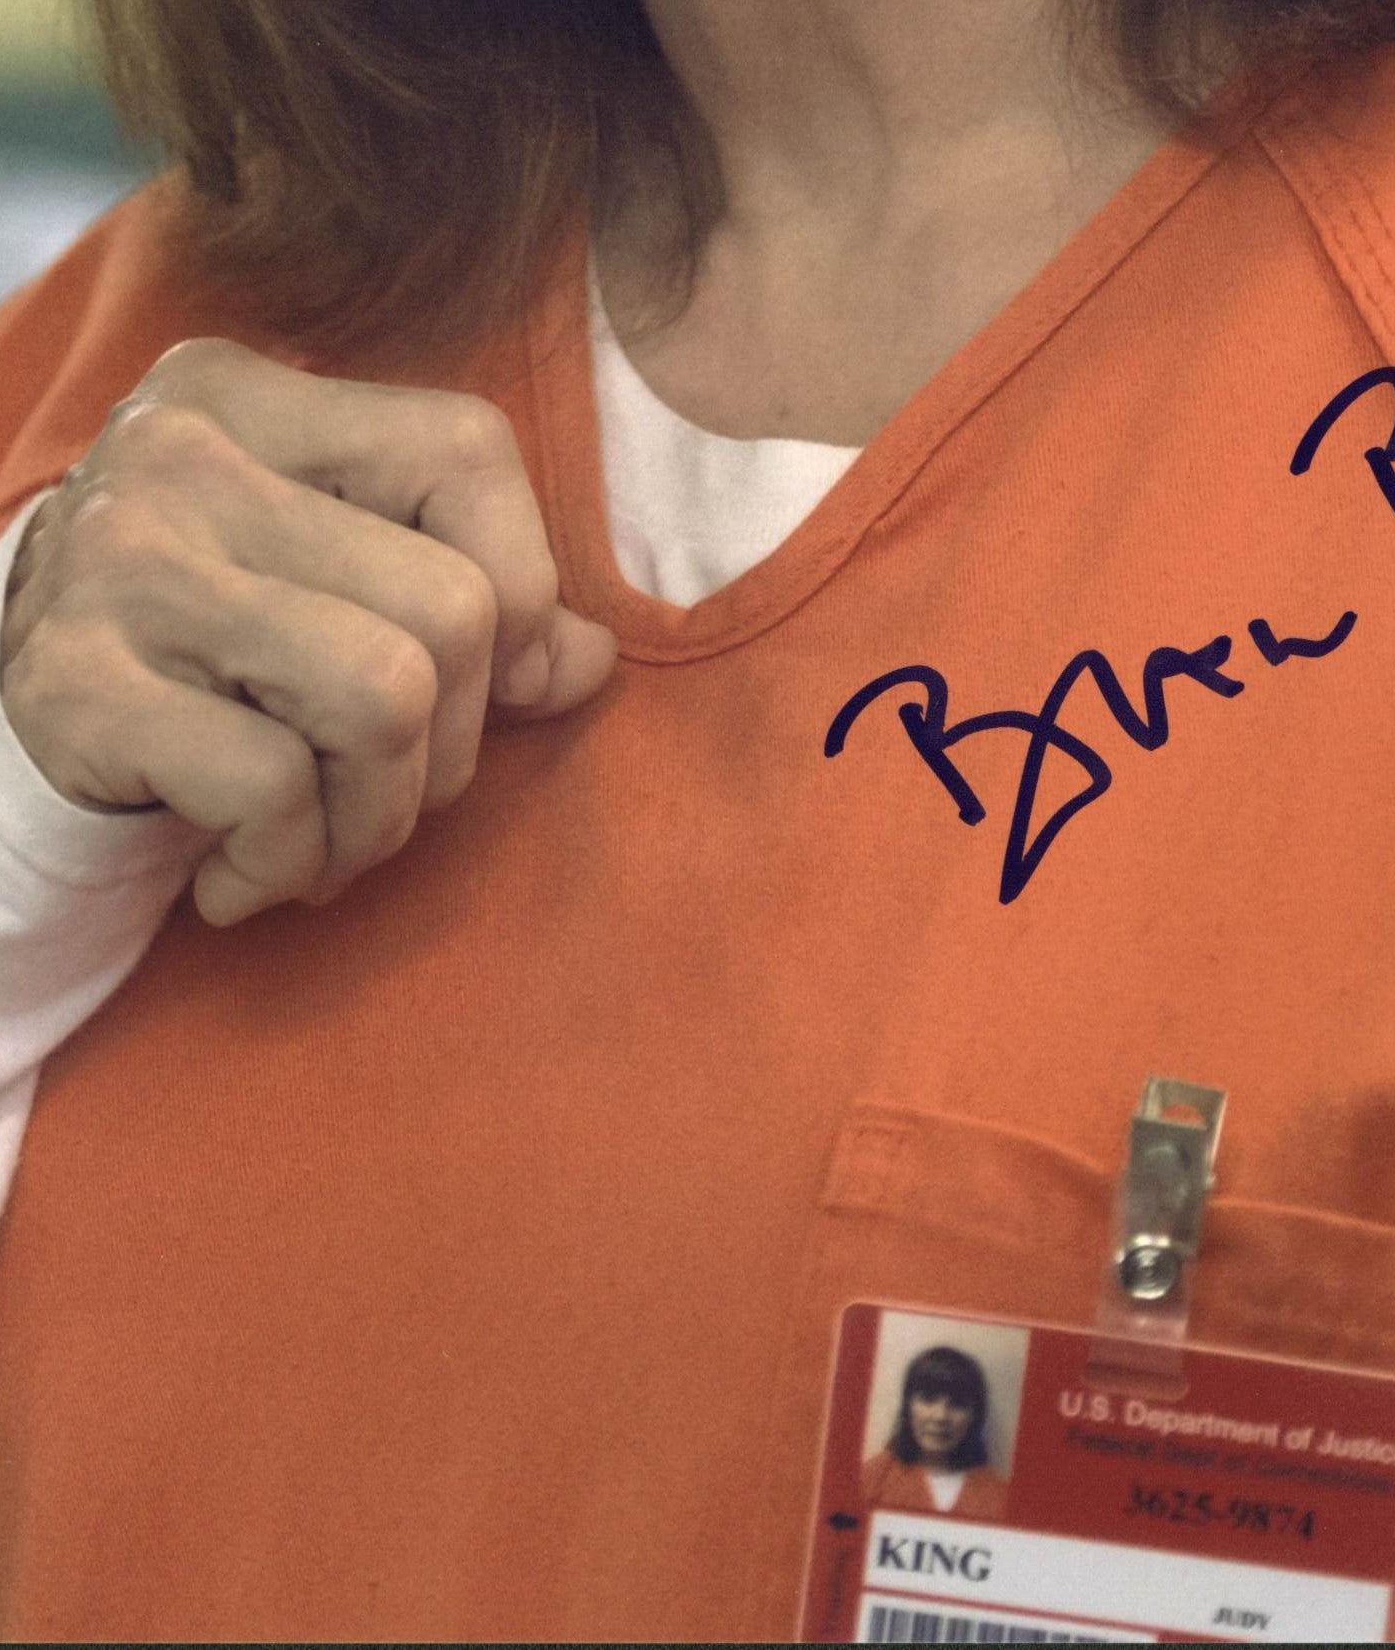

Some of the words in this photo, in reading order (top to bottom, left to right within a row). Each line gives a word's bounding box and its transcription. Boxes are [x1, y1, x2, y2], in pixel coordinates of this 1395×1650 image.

[1059, 1390, 1115, 1423] U.S.
[1124, 1399, 1278, 1448] Department
[1285, 1426, 1315, 1451] of
[876, 1535, 994, 1582] KING
